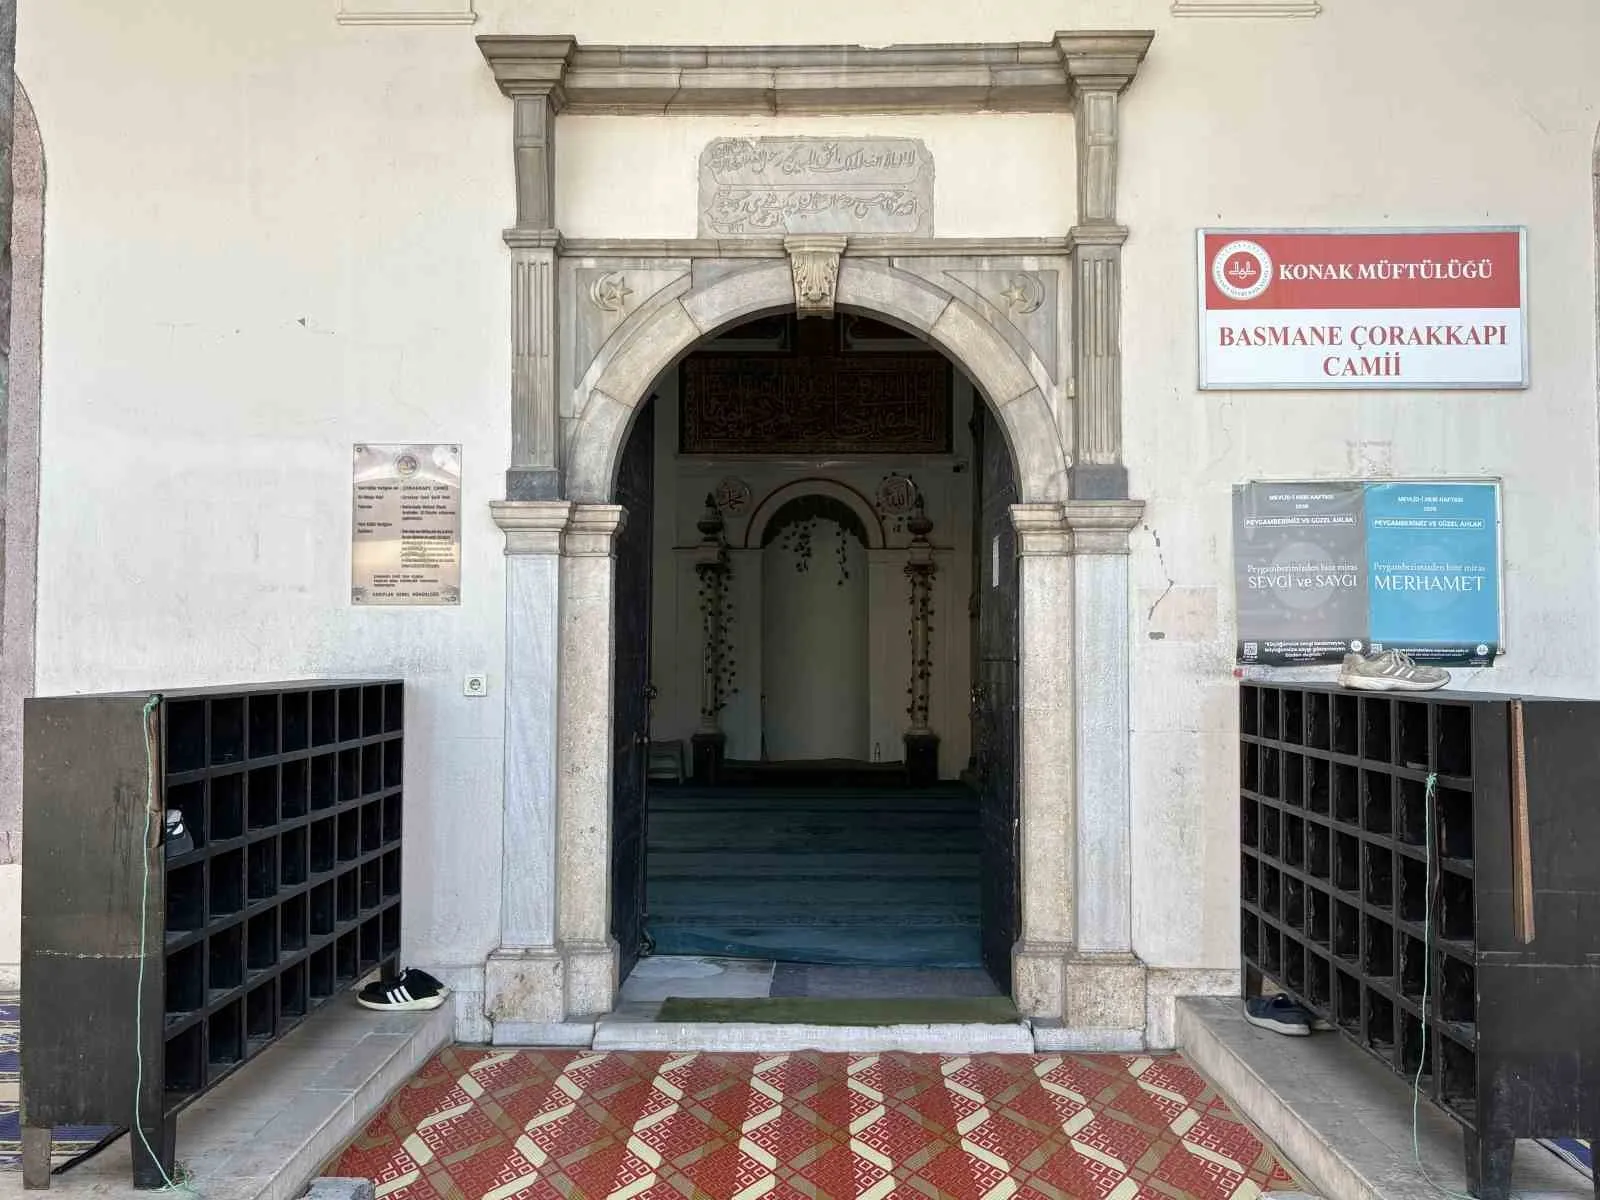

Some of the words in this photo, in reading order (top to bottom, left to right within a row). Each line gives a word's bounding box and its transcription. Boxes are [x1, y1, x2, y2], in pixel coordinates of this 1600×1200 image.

[1279, 263, 1353, 281] KONAK
[1357, 259, 1493, 280] MÜFTÜLÜĞÜ
[1219, 326, 1343, 347] BASMANE
[1350, 324, 1507, 350] ÇORAKKAPI
[1323, 351, 1401, 377] CAMİİ
[1248, 574, 1292, 589] SEVGİ
[1296, 577, 1312, 588] ve
[1315, 574, 1357, 587] SAYGI
[1374, 575, 1482, 592] MERHAMET
